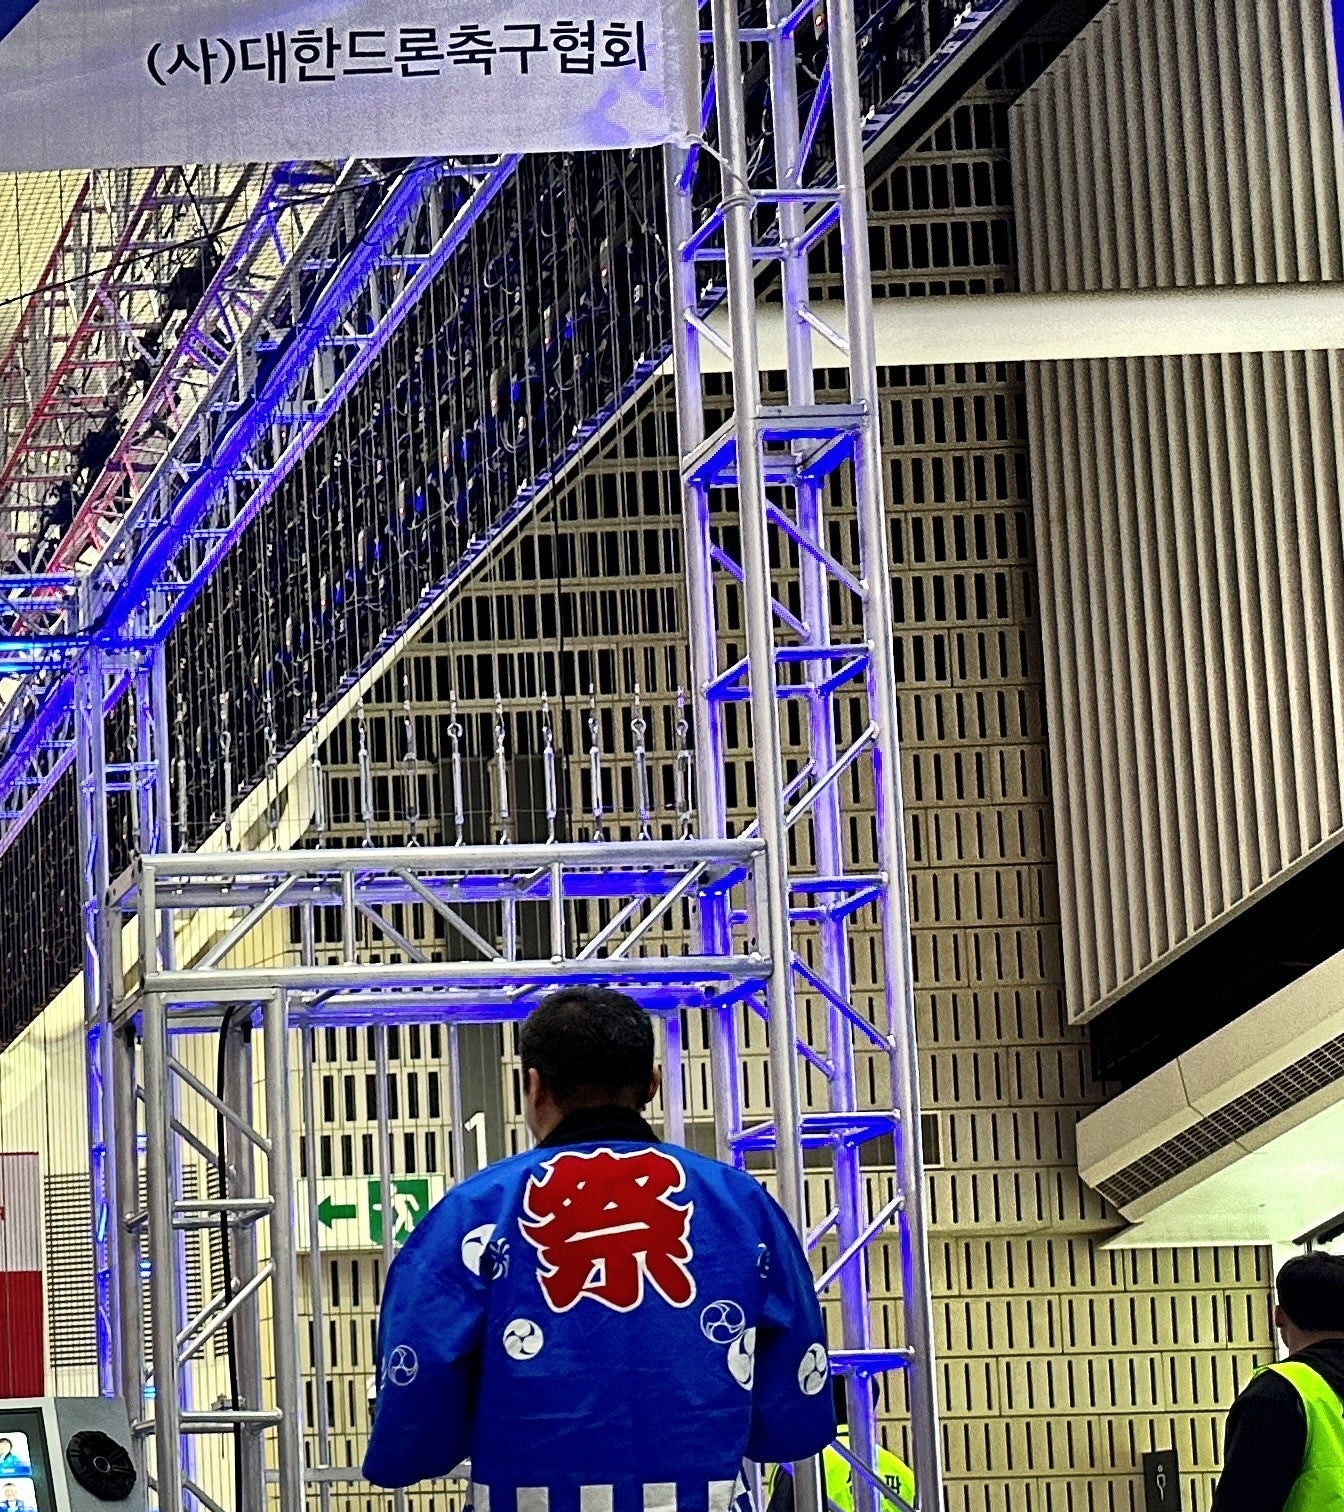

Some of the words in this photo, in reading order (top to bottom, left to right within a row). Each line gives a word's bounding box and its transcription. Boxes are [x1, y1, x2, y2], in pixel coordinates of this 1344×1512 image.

[145, 19, 649, 87] (사)대한드론축구협회
[464, 1111, 489, 1172] 1
[517, 1148, 697, 1313] 祭
